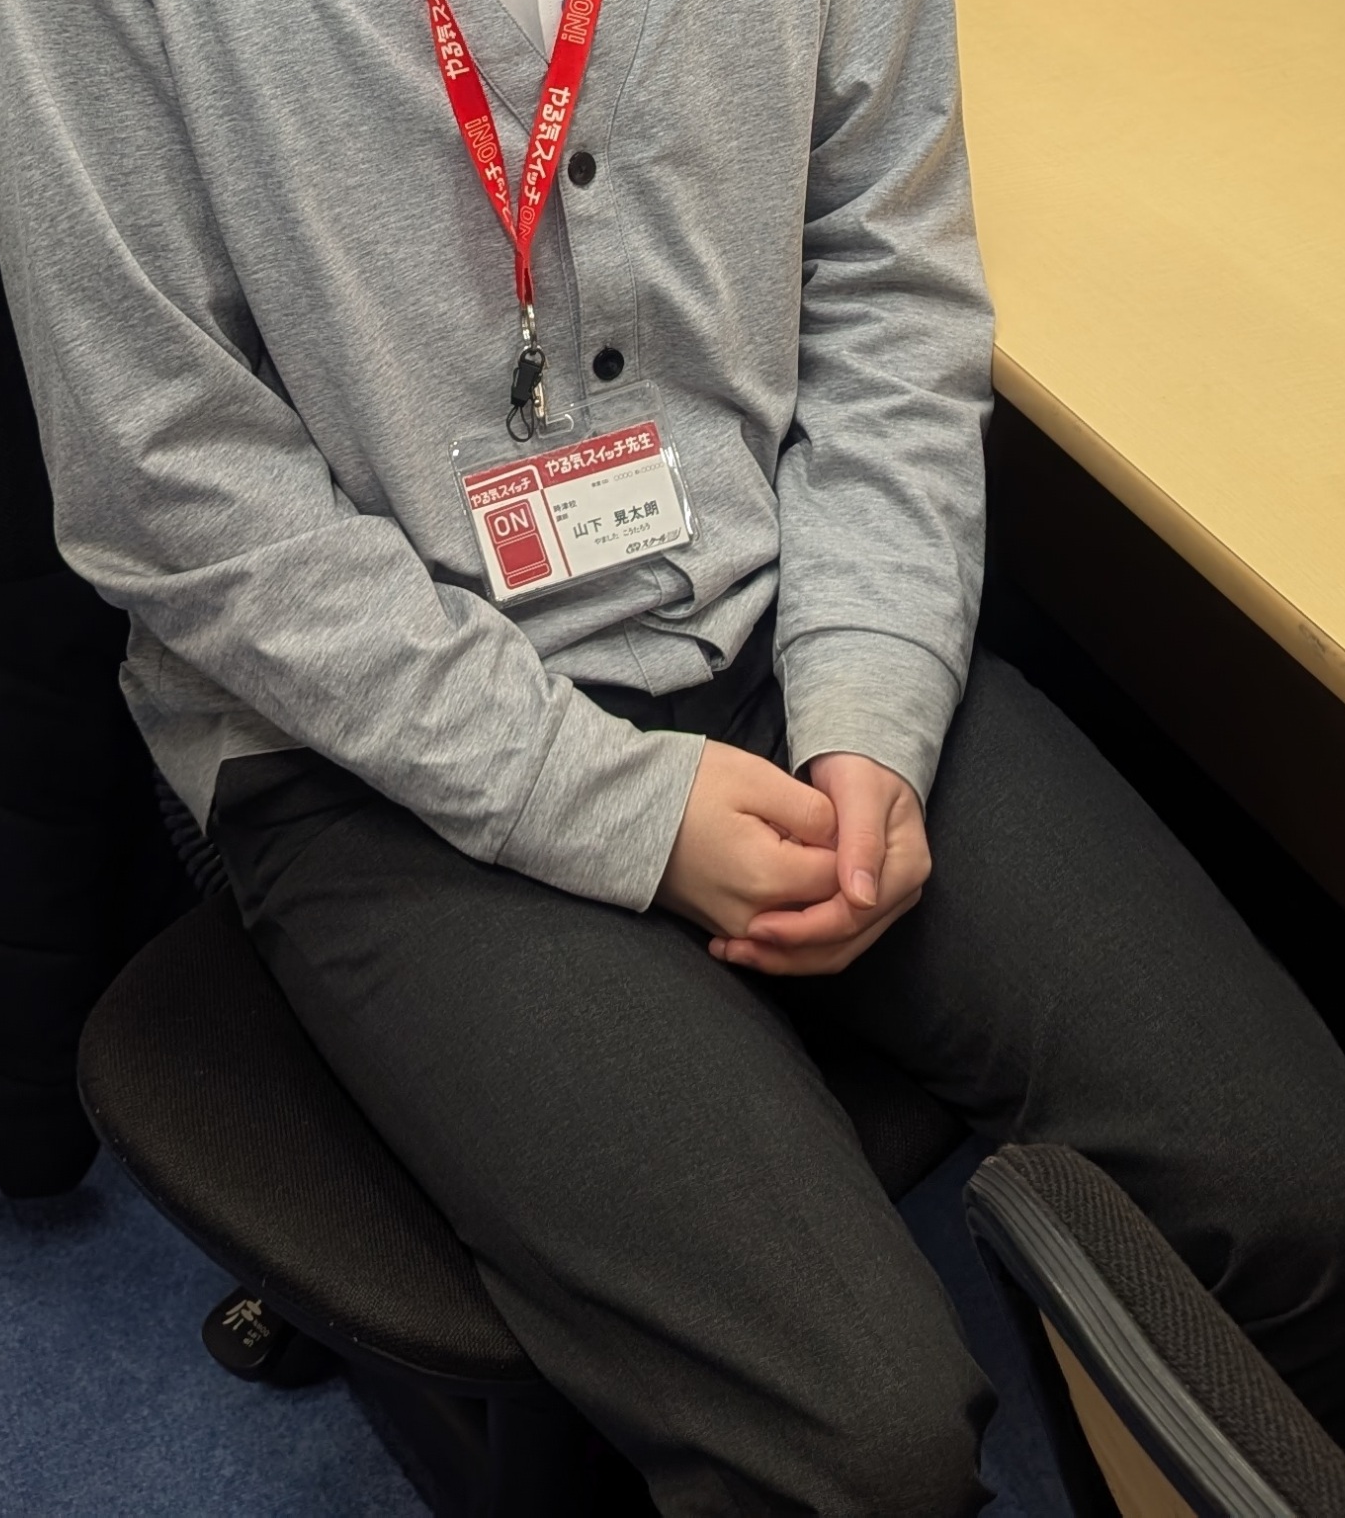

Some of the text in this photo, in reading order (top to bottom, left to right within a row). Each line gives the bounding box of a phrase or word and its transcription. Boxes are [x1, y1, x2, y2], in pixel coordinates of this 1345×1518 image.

[544, 432, 655, 478] やる気スイッチ先生
[470, 476, 532, 508] やる気スイッチ
[493, 508, 530, 537] ON
[572, 499, 660, 539] 山下 晃太朗
